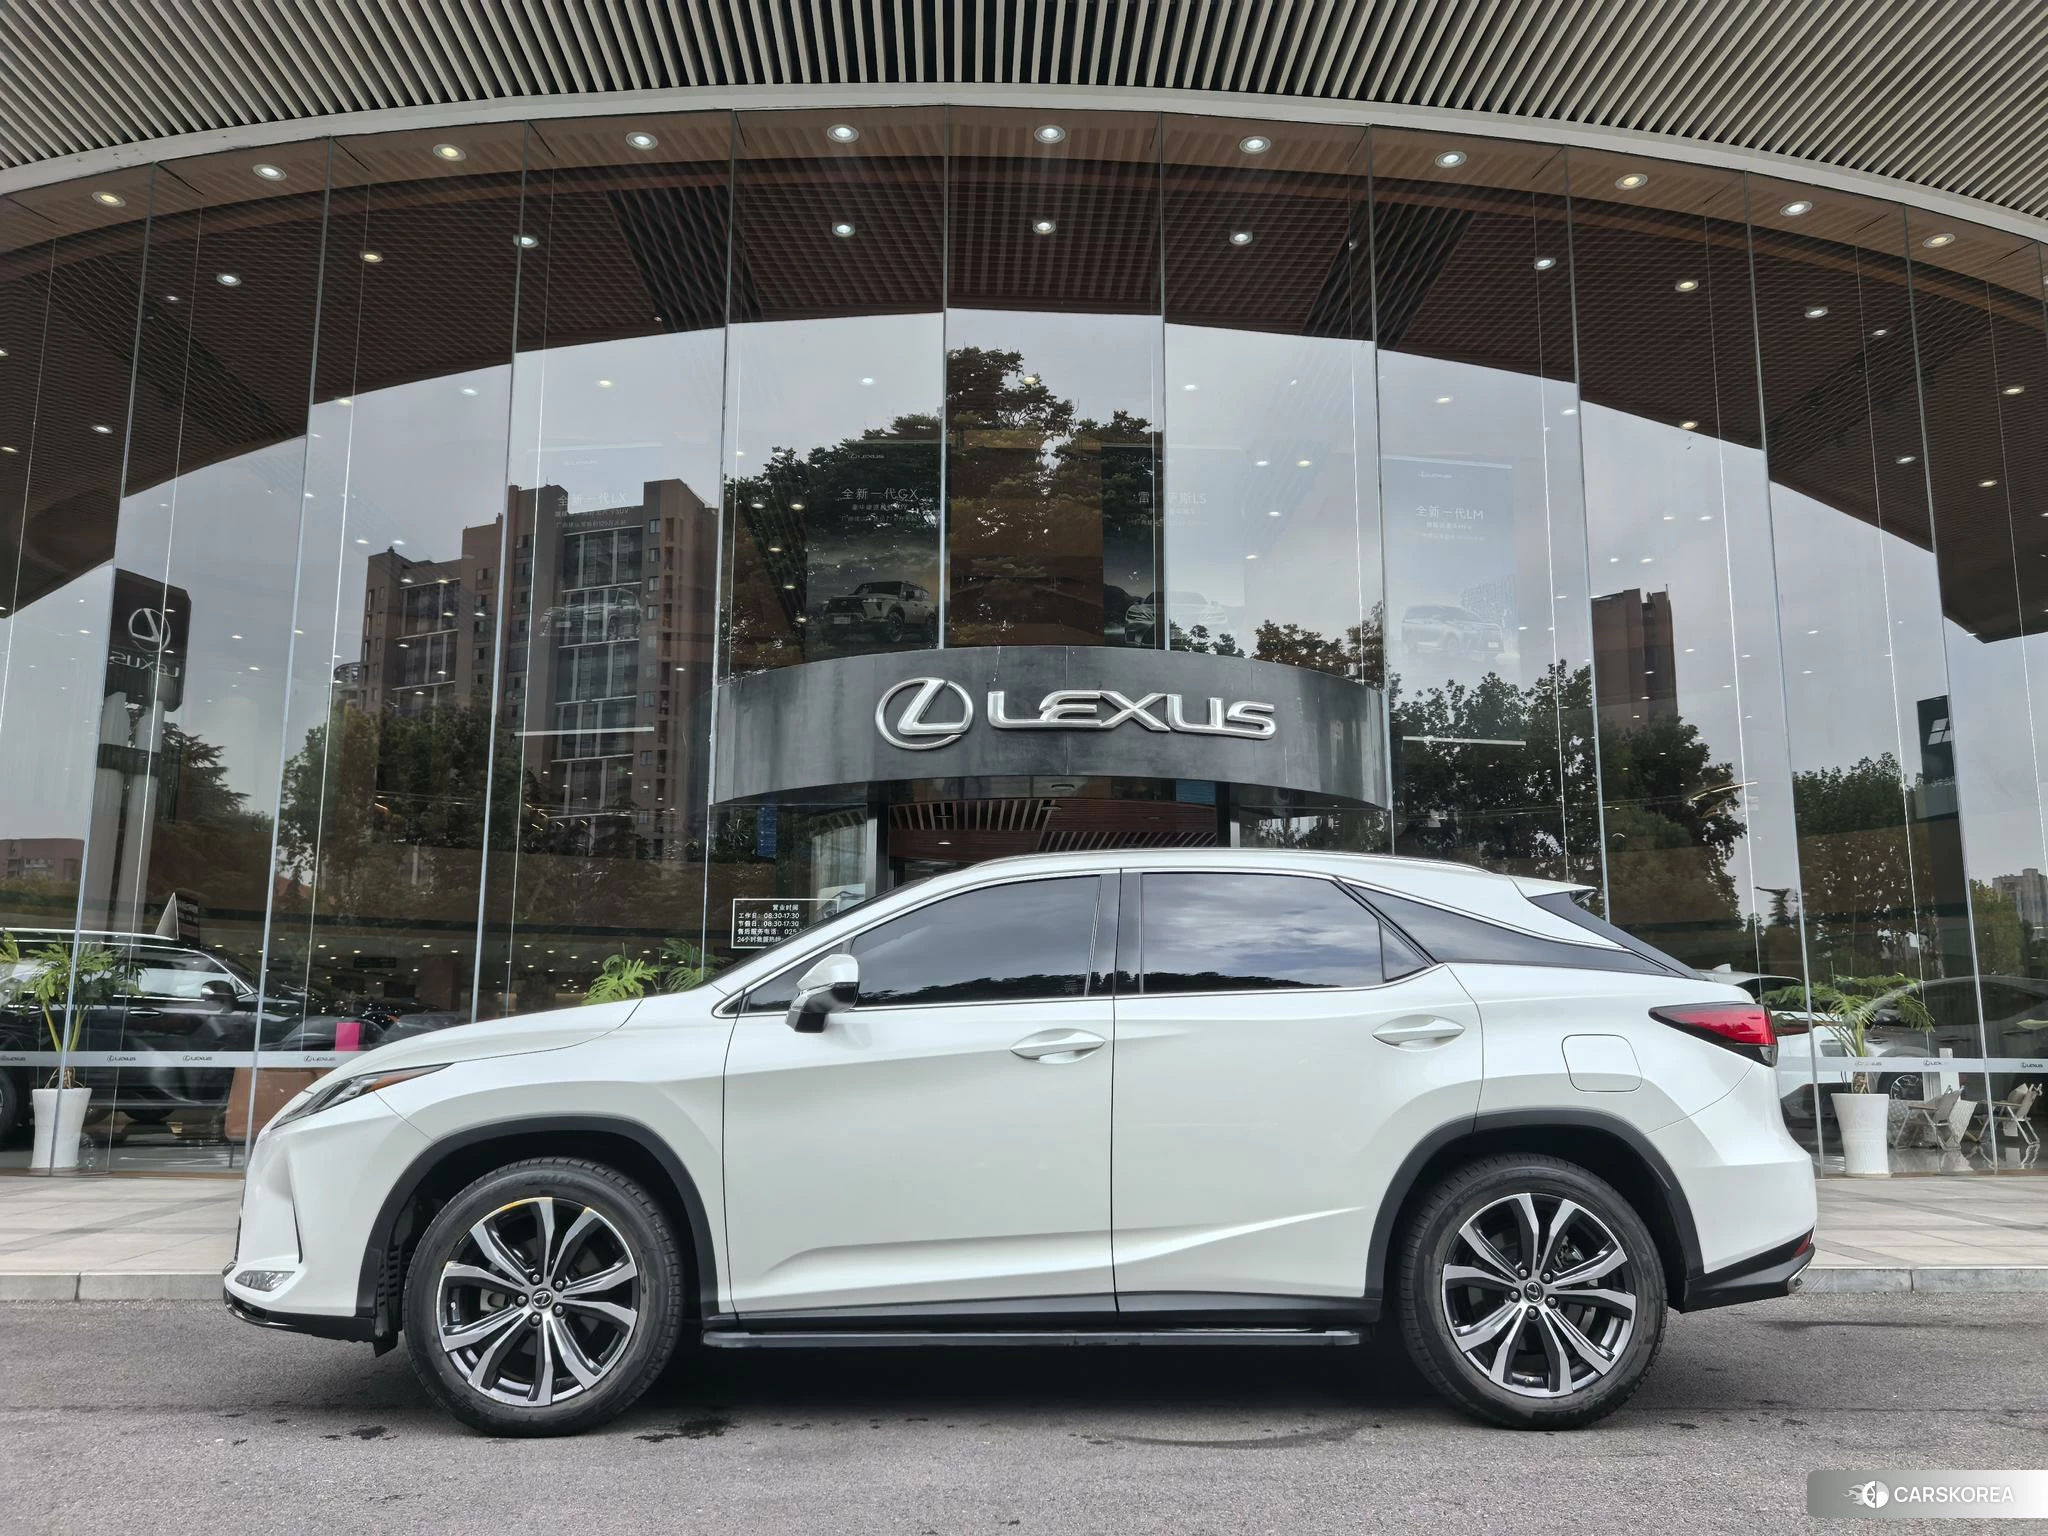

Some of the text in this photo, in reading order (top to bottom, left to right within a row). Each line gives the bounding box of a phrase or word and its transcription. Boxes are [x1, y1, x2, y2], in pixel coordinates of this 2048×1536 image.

[841, 488, 919, 501] 全新一代GX
[987, 689, 1277, 740] LEXUS
